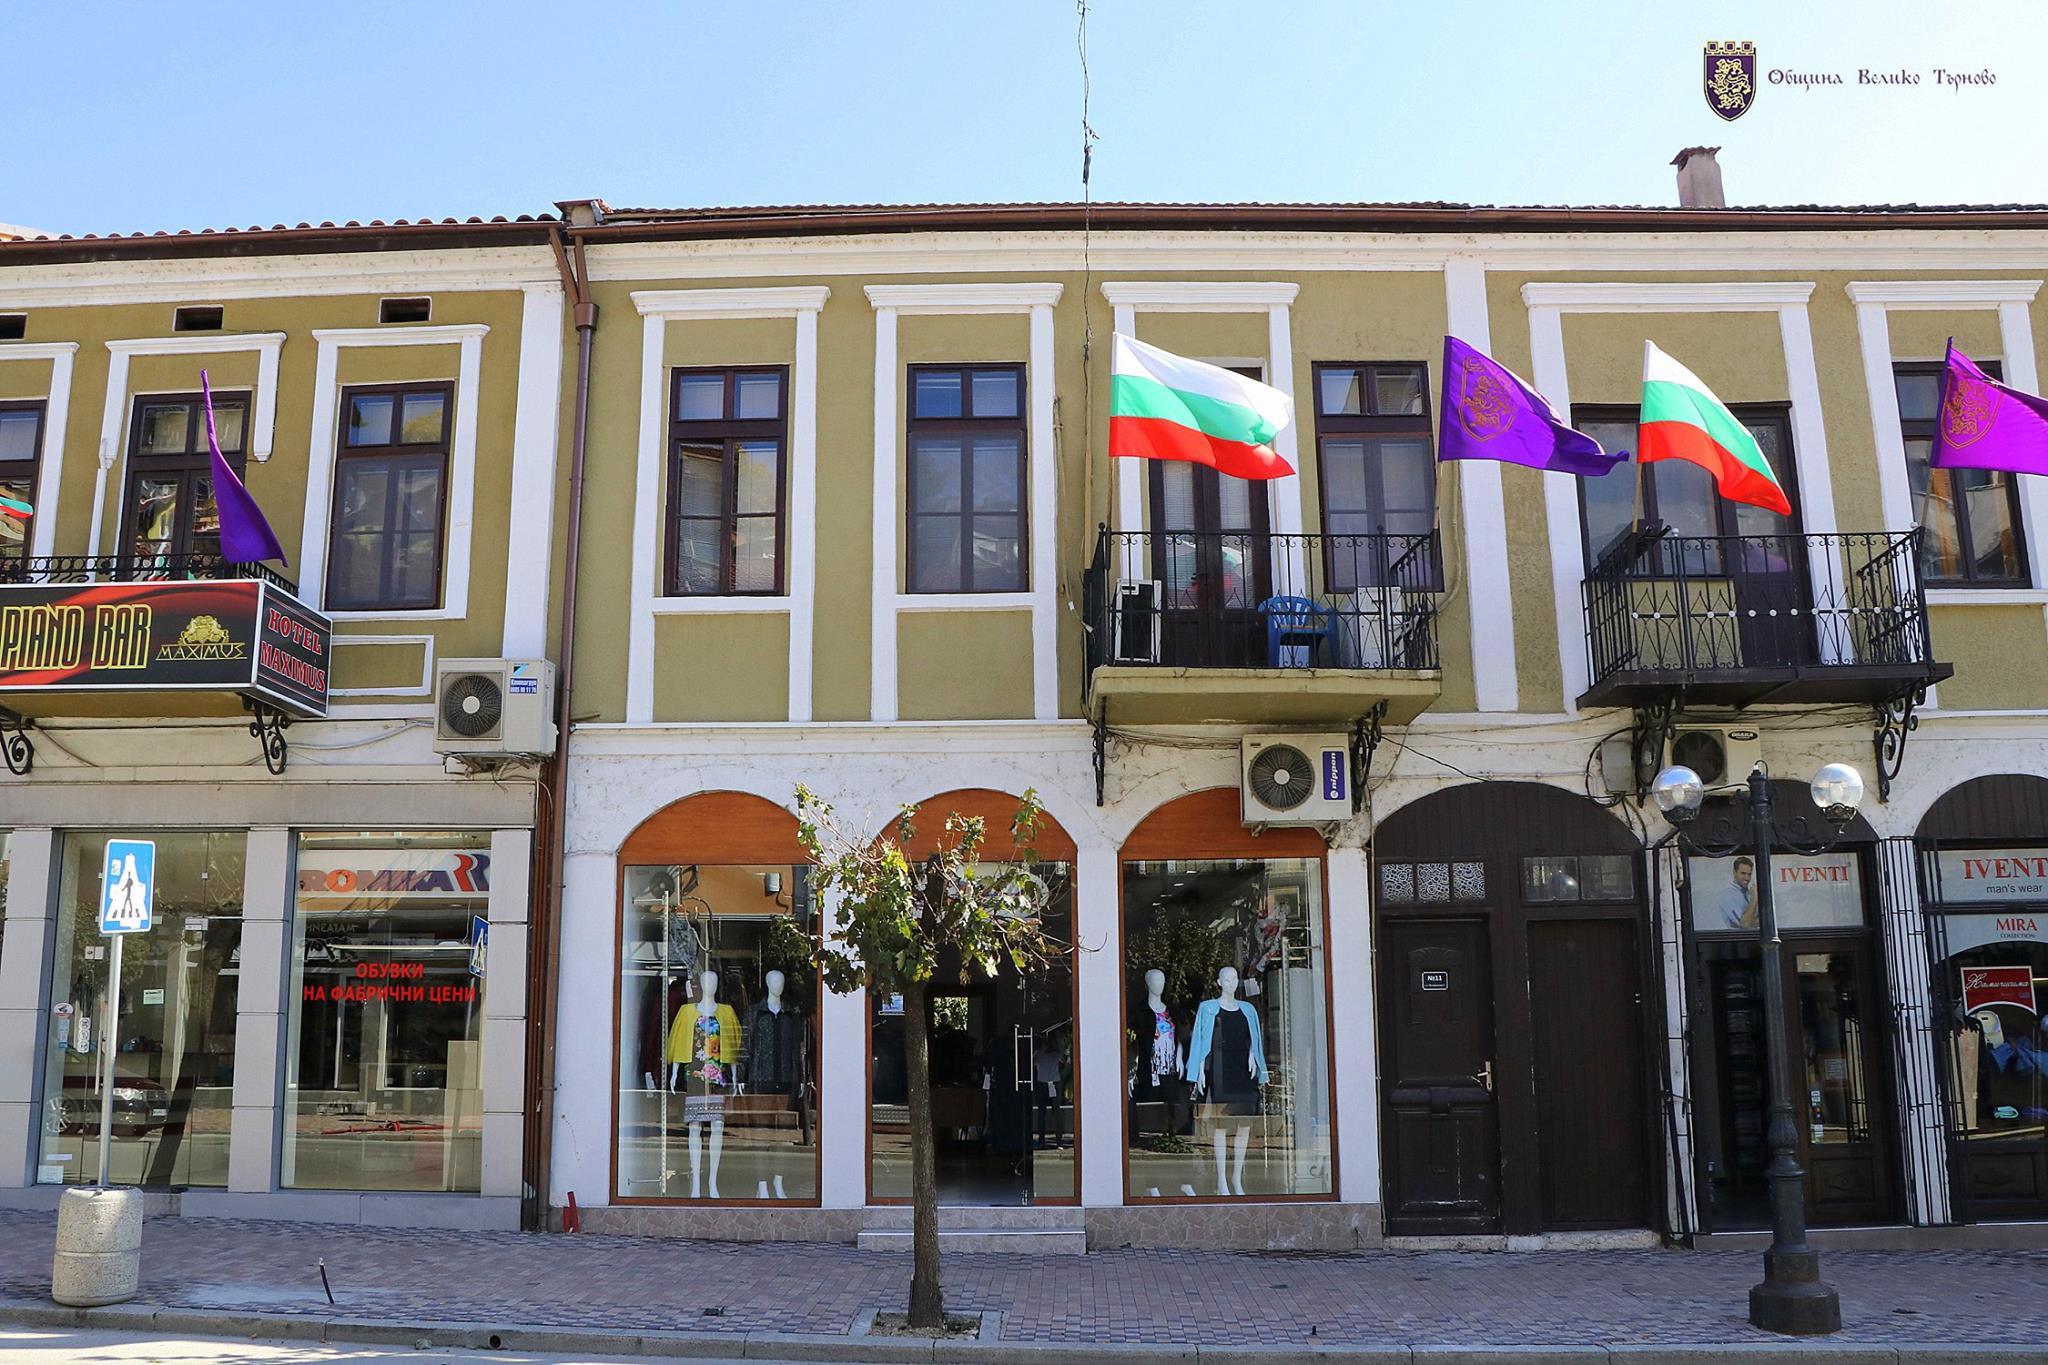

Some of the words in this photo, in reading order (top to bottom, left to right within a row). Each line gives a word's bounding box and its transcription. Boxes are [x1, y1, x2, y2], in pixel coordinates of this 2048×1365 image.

[0, 603, 85, 671] PIANO
[91, 604, 152, 670] BAR
[267, 607, 323, 656] HOTEL
[155, 642, 248, 661] MAXIMUS
[260, 640, 326, 693] MAXIMUS
[1330, 752, 1338, 789] nippon
[1780, 865, 1848, 882] IVENTI
[1961, 857, 2048, 880] IVENT
[1986, 884, 2016, 894] man's
[2018, 884, 2043, 893] wear
[1996, 918, 2038, 931] MIRA
[355, 963, 424, 978] ОБУВКИ
[303, 986, 326, 1001] НА
[330, 985, 425, 1002] ФАБРИЧНИ
[430, 986, 477, 1004] ЦЕНИ
